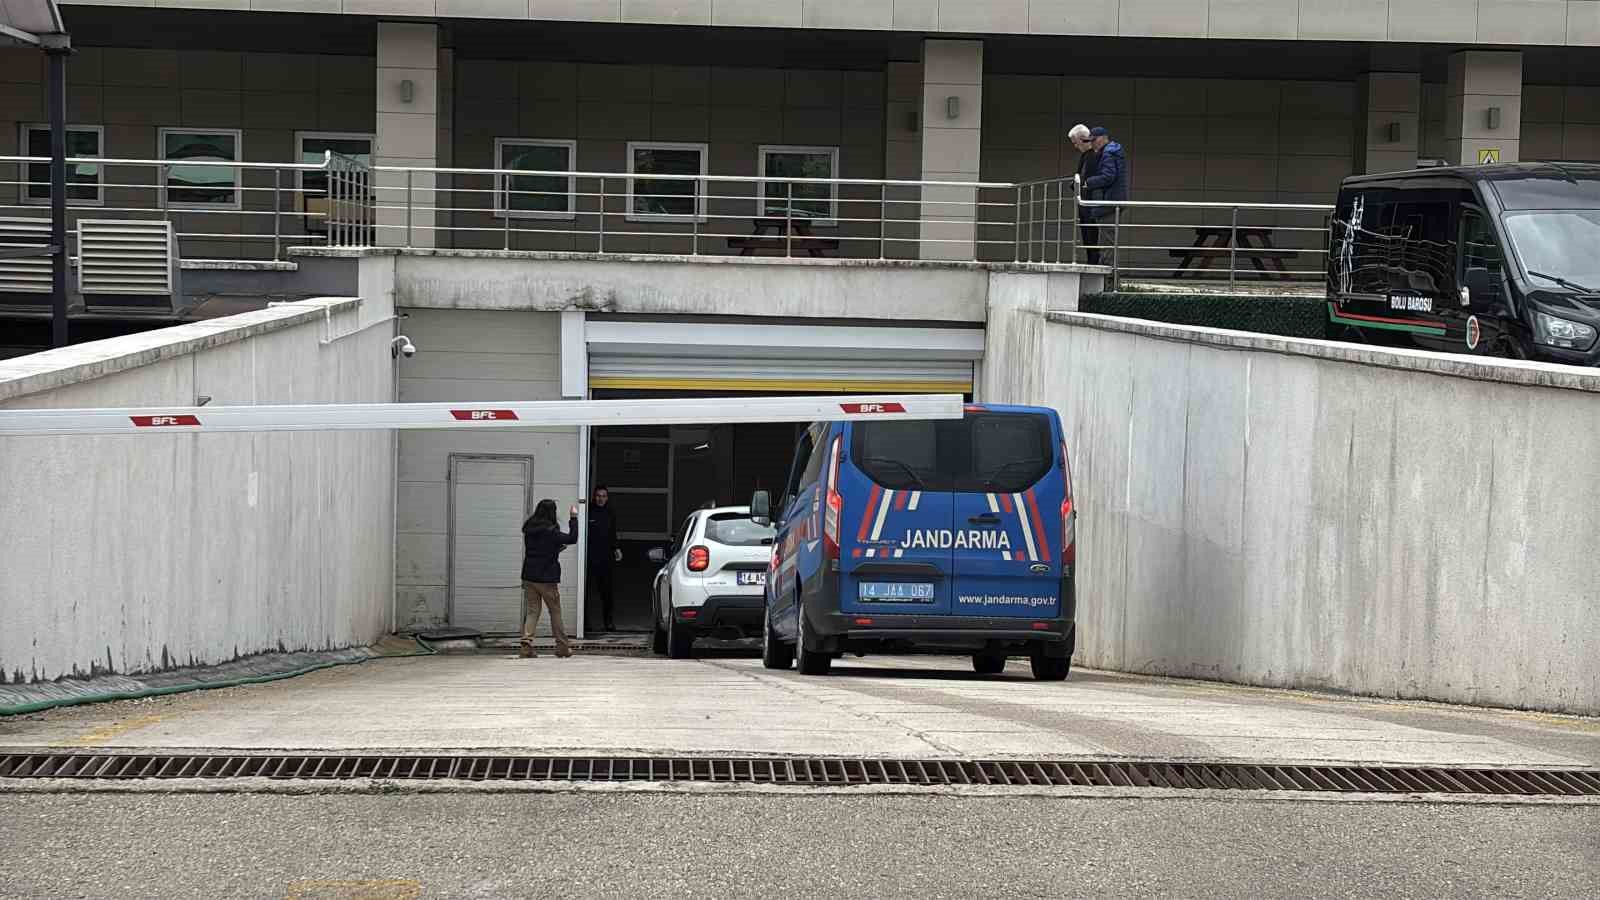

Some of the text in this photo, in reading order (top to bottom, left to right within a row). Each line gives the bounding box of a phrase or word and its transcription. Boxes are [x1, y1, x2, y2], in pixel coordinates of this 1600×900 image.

[1391, 296, 1432, 312] BOLU BAROSU
[900, 529, 1011, 549] JANDARMA
[863, 583, 875, 595] 14
[883, 583, 904, 596] JAA
[958, 594, 1057, 607] www.jandarma.gov.tr
